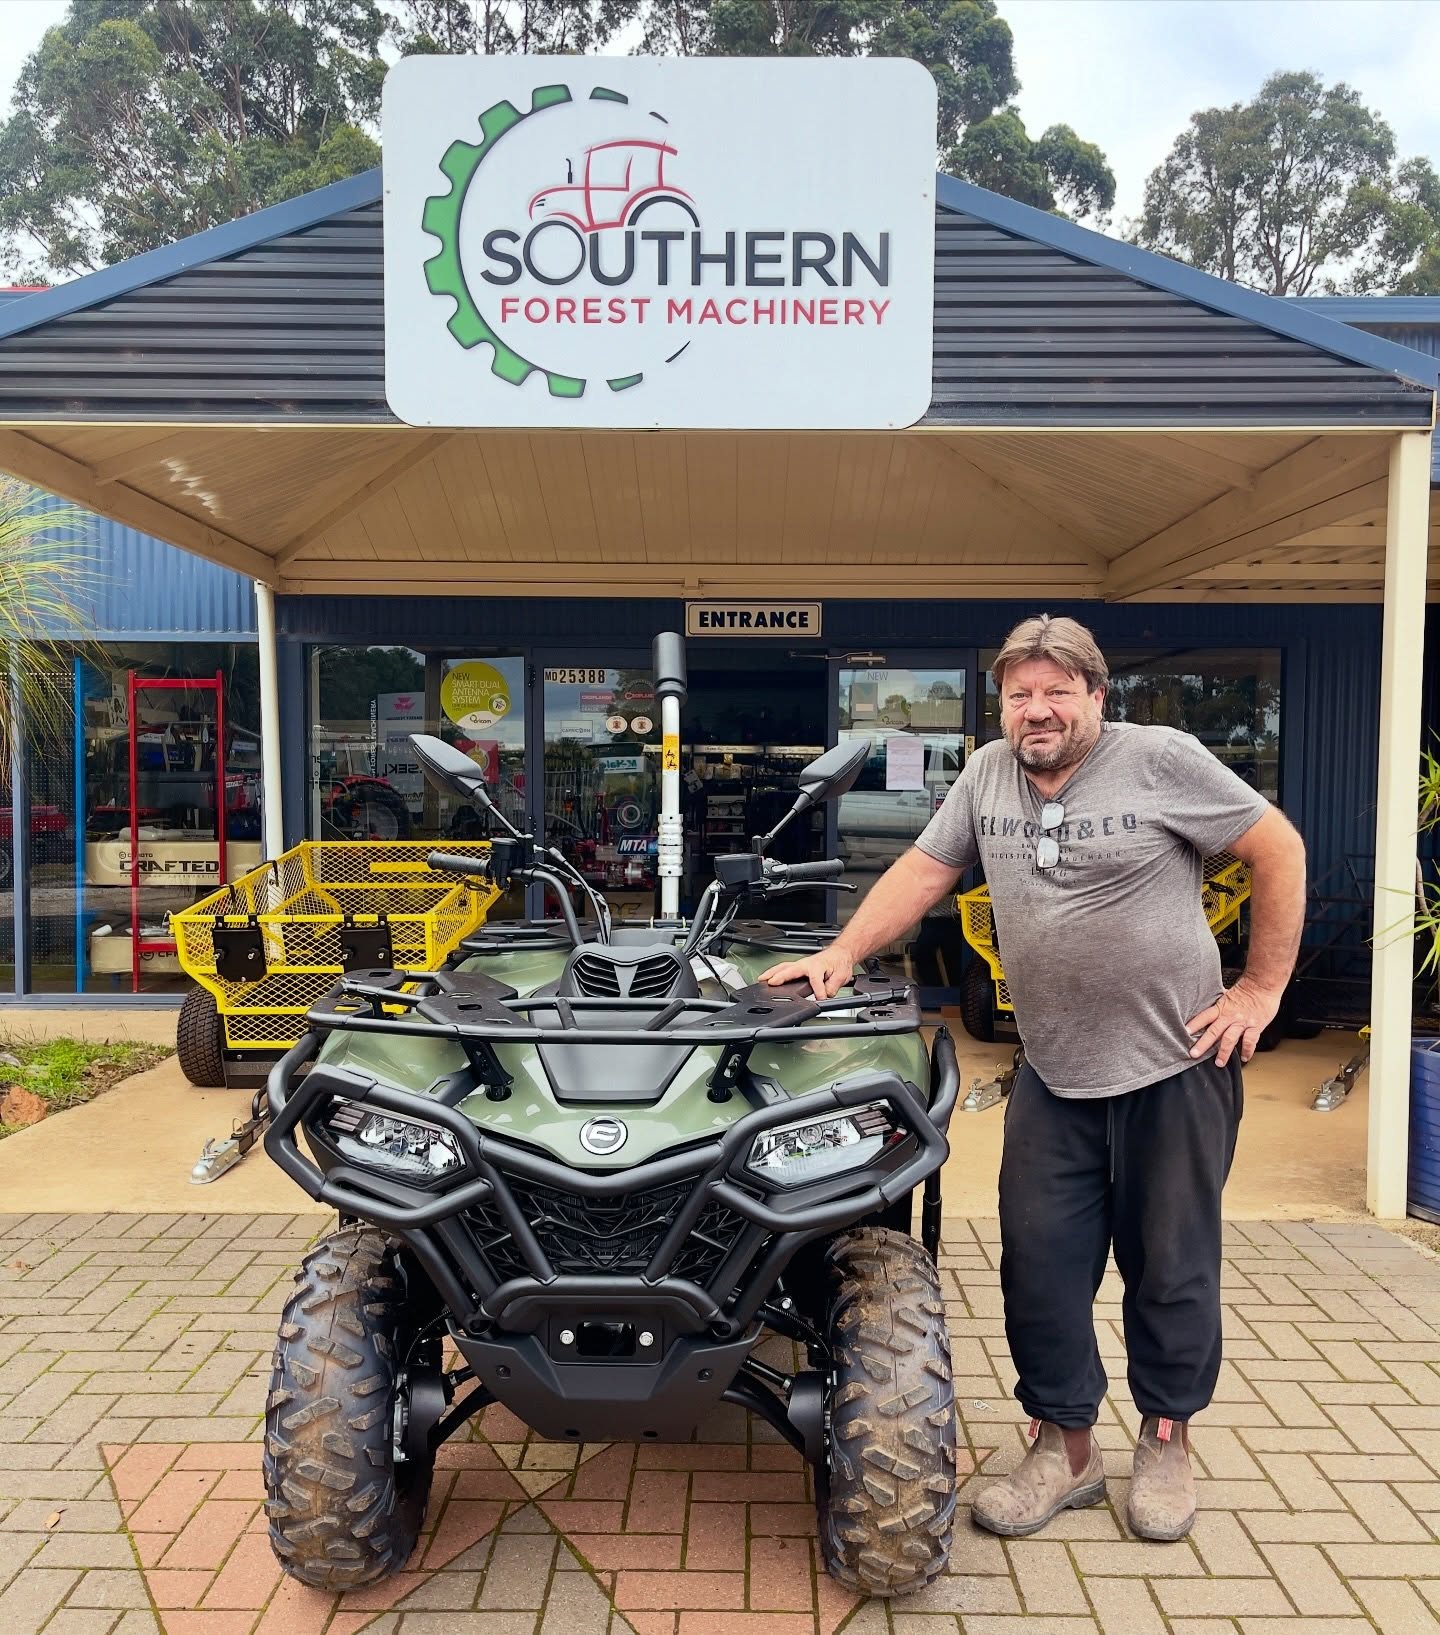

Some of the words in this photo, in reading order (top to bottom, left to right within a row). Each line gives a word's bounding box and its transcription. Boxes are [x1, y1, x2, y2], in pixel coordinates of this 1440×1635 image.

[481, 221, 891, 287] SOUTHERN
[501, 298, 651, 324] FOREST
[666, 298, 892, 325] MACHINERY
[699, 611, 809, 628] ENTRANCE
[452, 672, 470, 680] NEW
[559, 669, 606, 684] 25388
[867, 671, 889, 681] NEW
[452, 680, 479, 688] SMART
[480, 680, 501, 688] DUAL
[452, 688, 490, 696] ANTENNA
[452, 695, 481, 704] SYSTEM
[620, 839, 647, 852] MTA
[119, 860, 219, 872] CRAFTED
